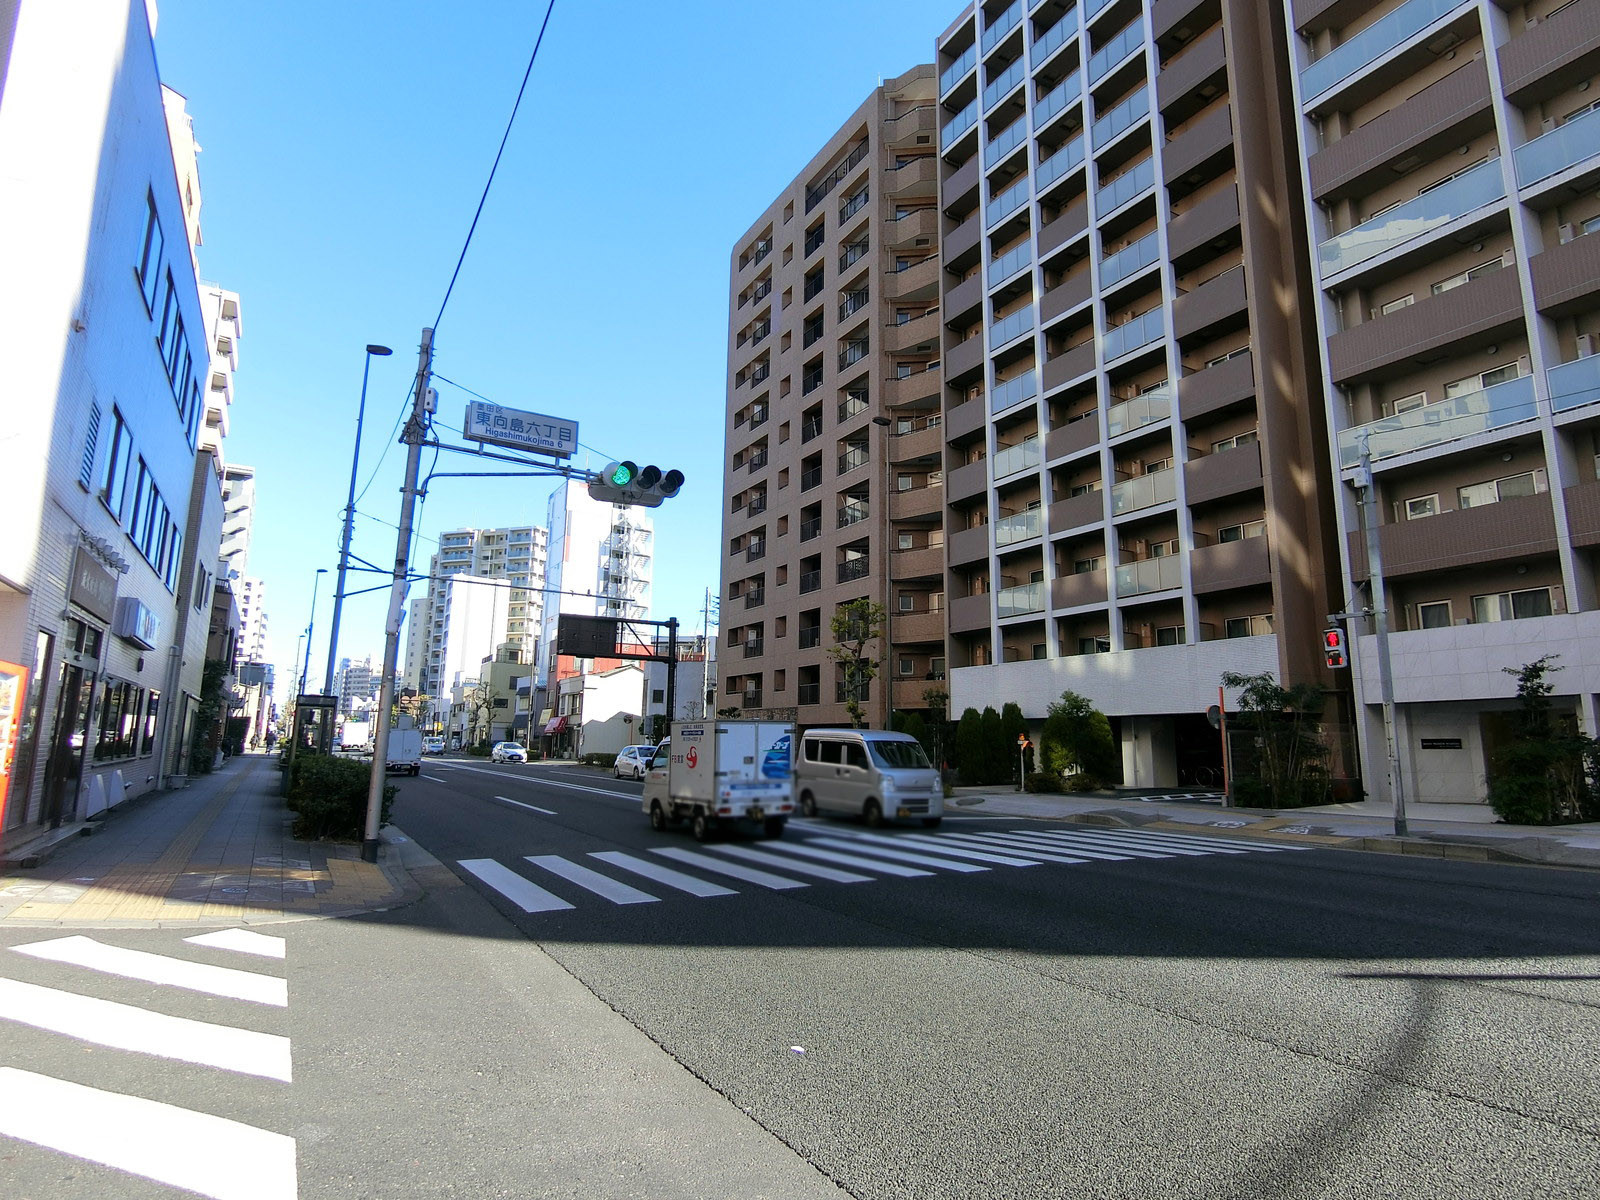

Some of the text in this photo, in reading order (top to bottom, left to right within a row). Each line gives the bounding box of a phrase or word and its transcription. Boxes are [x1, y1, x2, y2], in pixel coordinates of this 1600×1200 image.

[476, 411, 572, 442] 東向島六丁目
[485, 427, 555, 447] Higashimukojima
